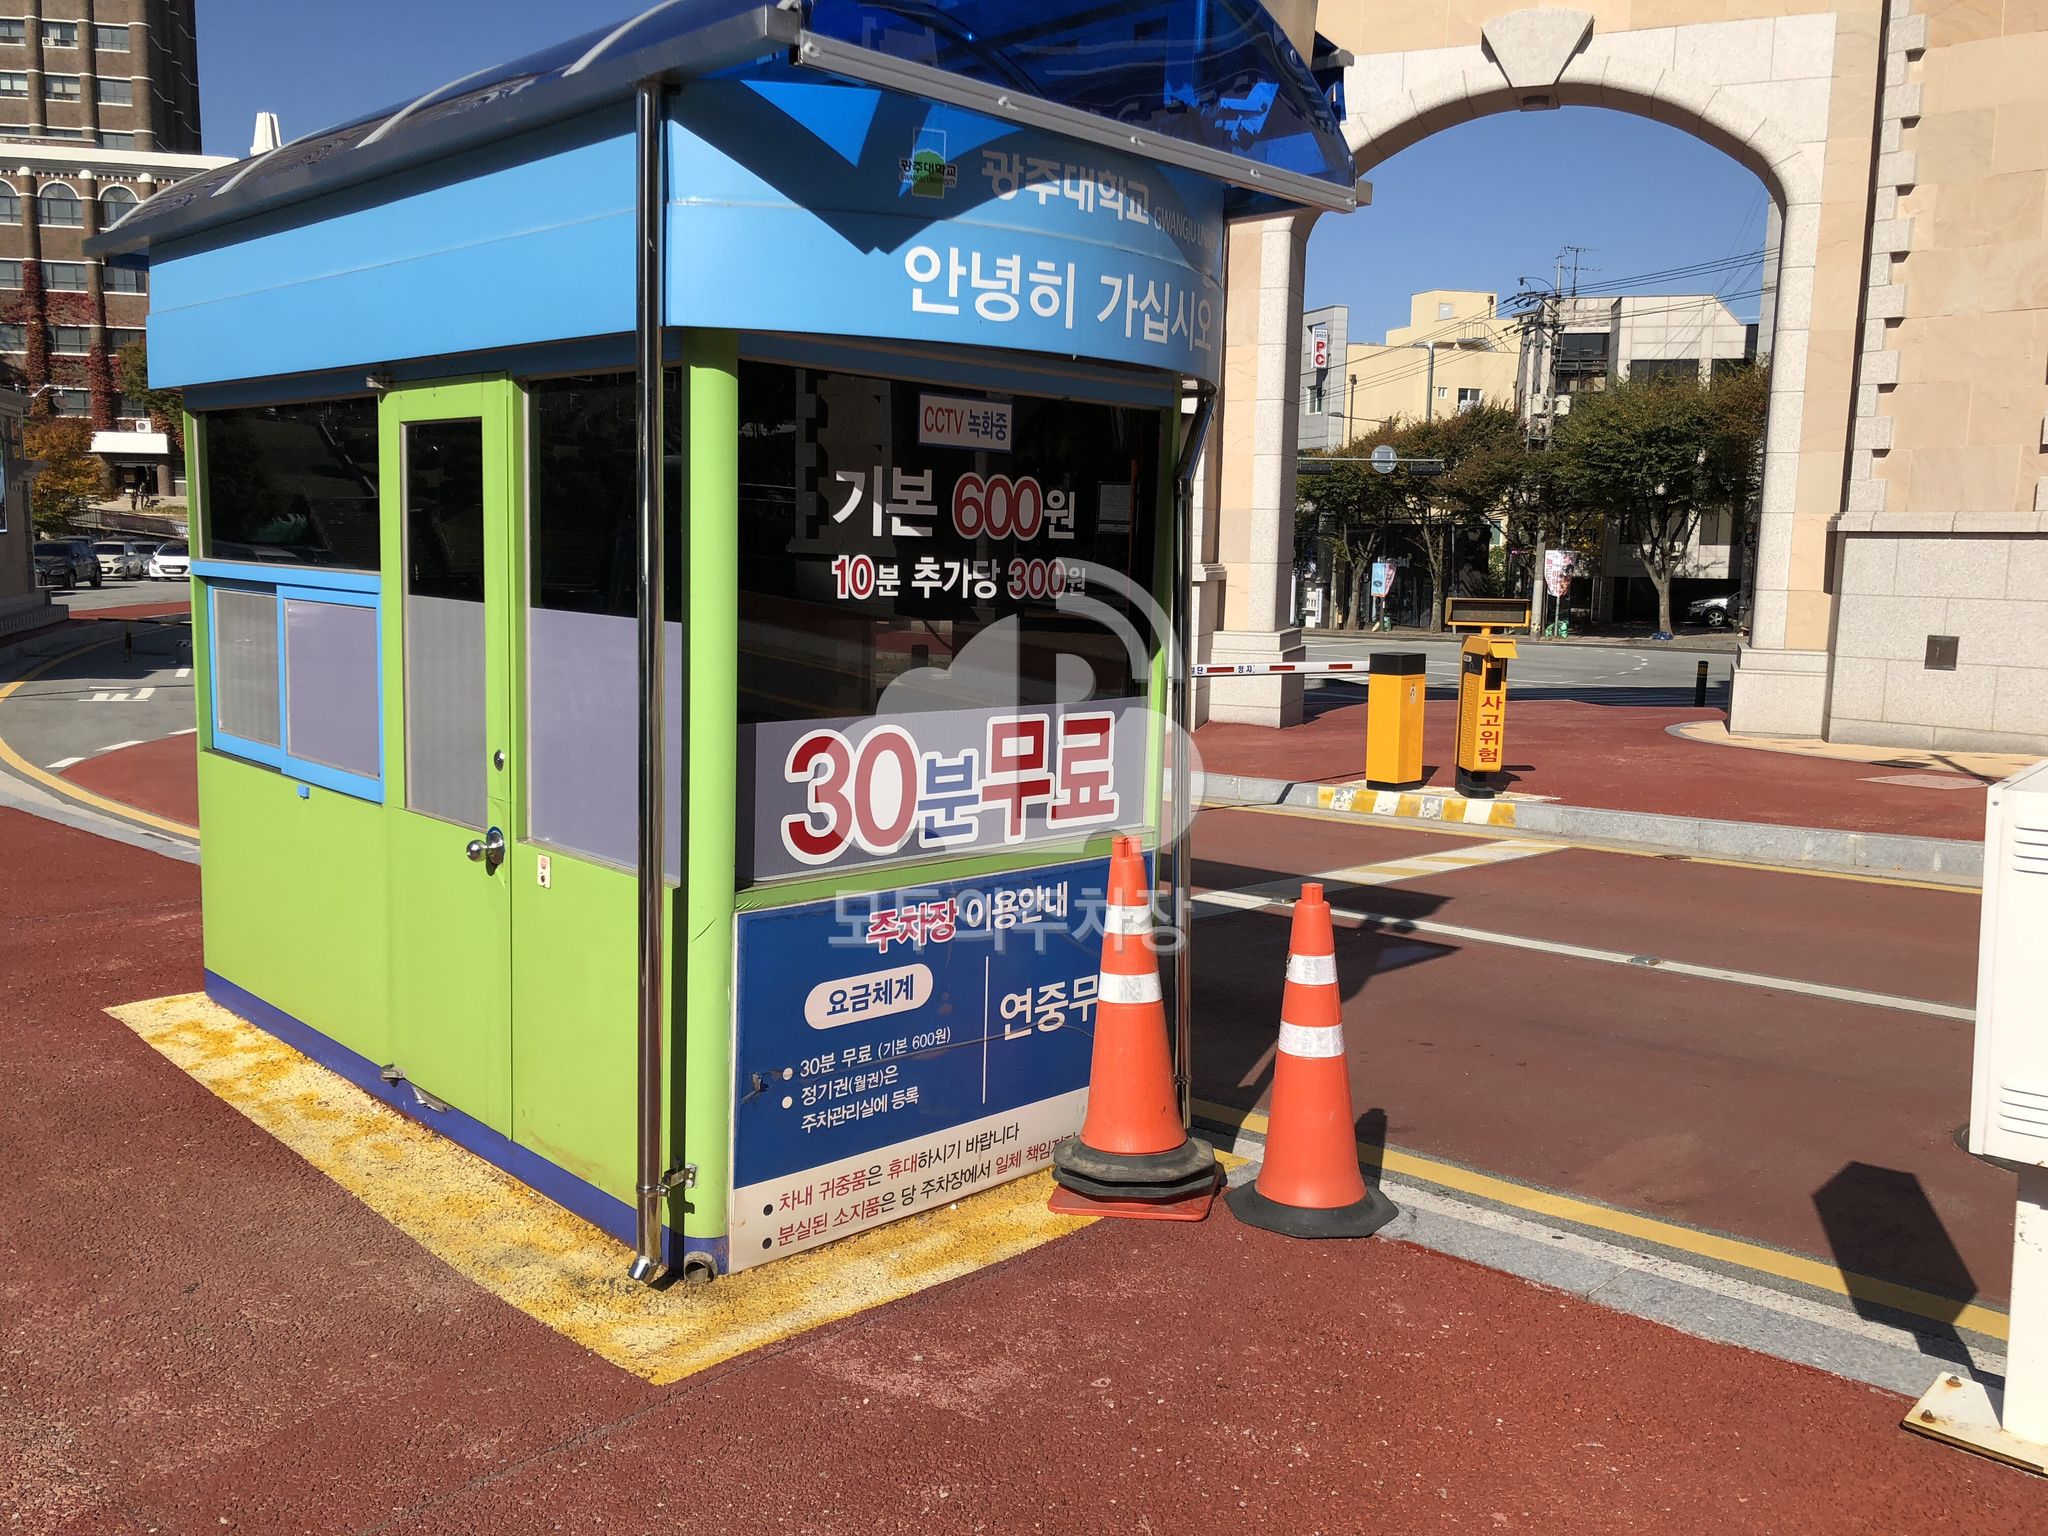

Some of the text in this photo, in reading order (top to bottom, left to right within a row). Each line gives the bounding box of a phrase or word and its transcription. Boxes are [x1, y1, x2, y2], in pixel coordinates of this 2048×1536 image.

[900, 159, 957, 177] 광주대학교
[982, 150, 1149, 225] 광주대학교
[1154, 207, 1197, 243] GWANGJU
[904, 246, 1212, 351] 안녕히 가십시오
[924, 406, 1008, 441] CCTV 녹화중
[832, 465, 938, 536] 기본
[952, 472, 1075, 541] 600원
[831, 554, 1086, 599] 10분 추가당 300원
[1479, 696, 1503, 763] 사고위험
[781, 711, 1119, 866] 30분무료
[866, 881, 1068, 954] 주차장 이용안내
[826, 974, 914, 1016] 요금체계
[800, 1026, 951, 1077] 30분 무료 (기본 600원)
[801, 1065, 899, 1106] 정기권(월권)은
[801, 1085, 920, 1134] 주차관리실에 등록
[779, 1122, 1020, 1212] 차내 귀중품은 휴대하시기 바랍니다
[777, 1212, 828, 1247] 분실된
[832, 1191, 896, 1227] 소지품은
[901, 1185, 917, 1207] 당
[920, 1160, 991, 1200] 주차장에서
[995, 1150, 1023, 1176] 일체
